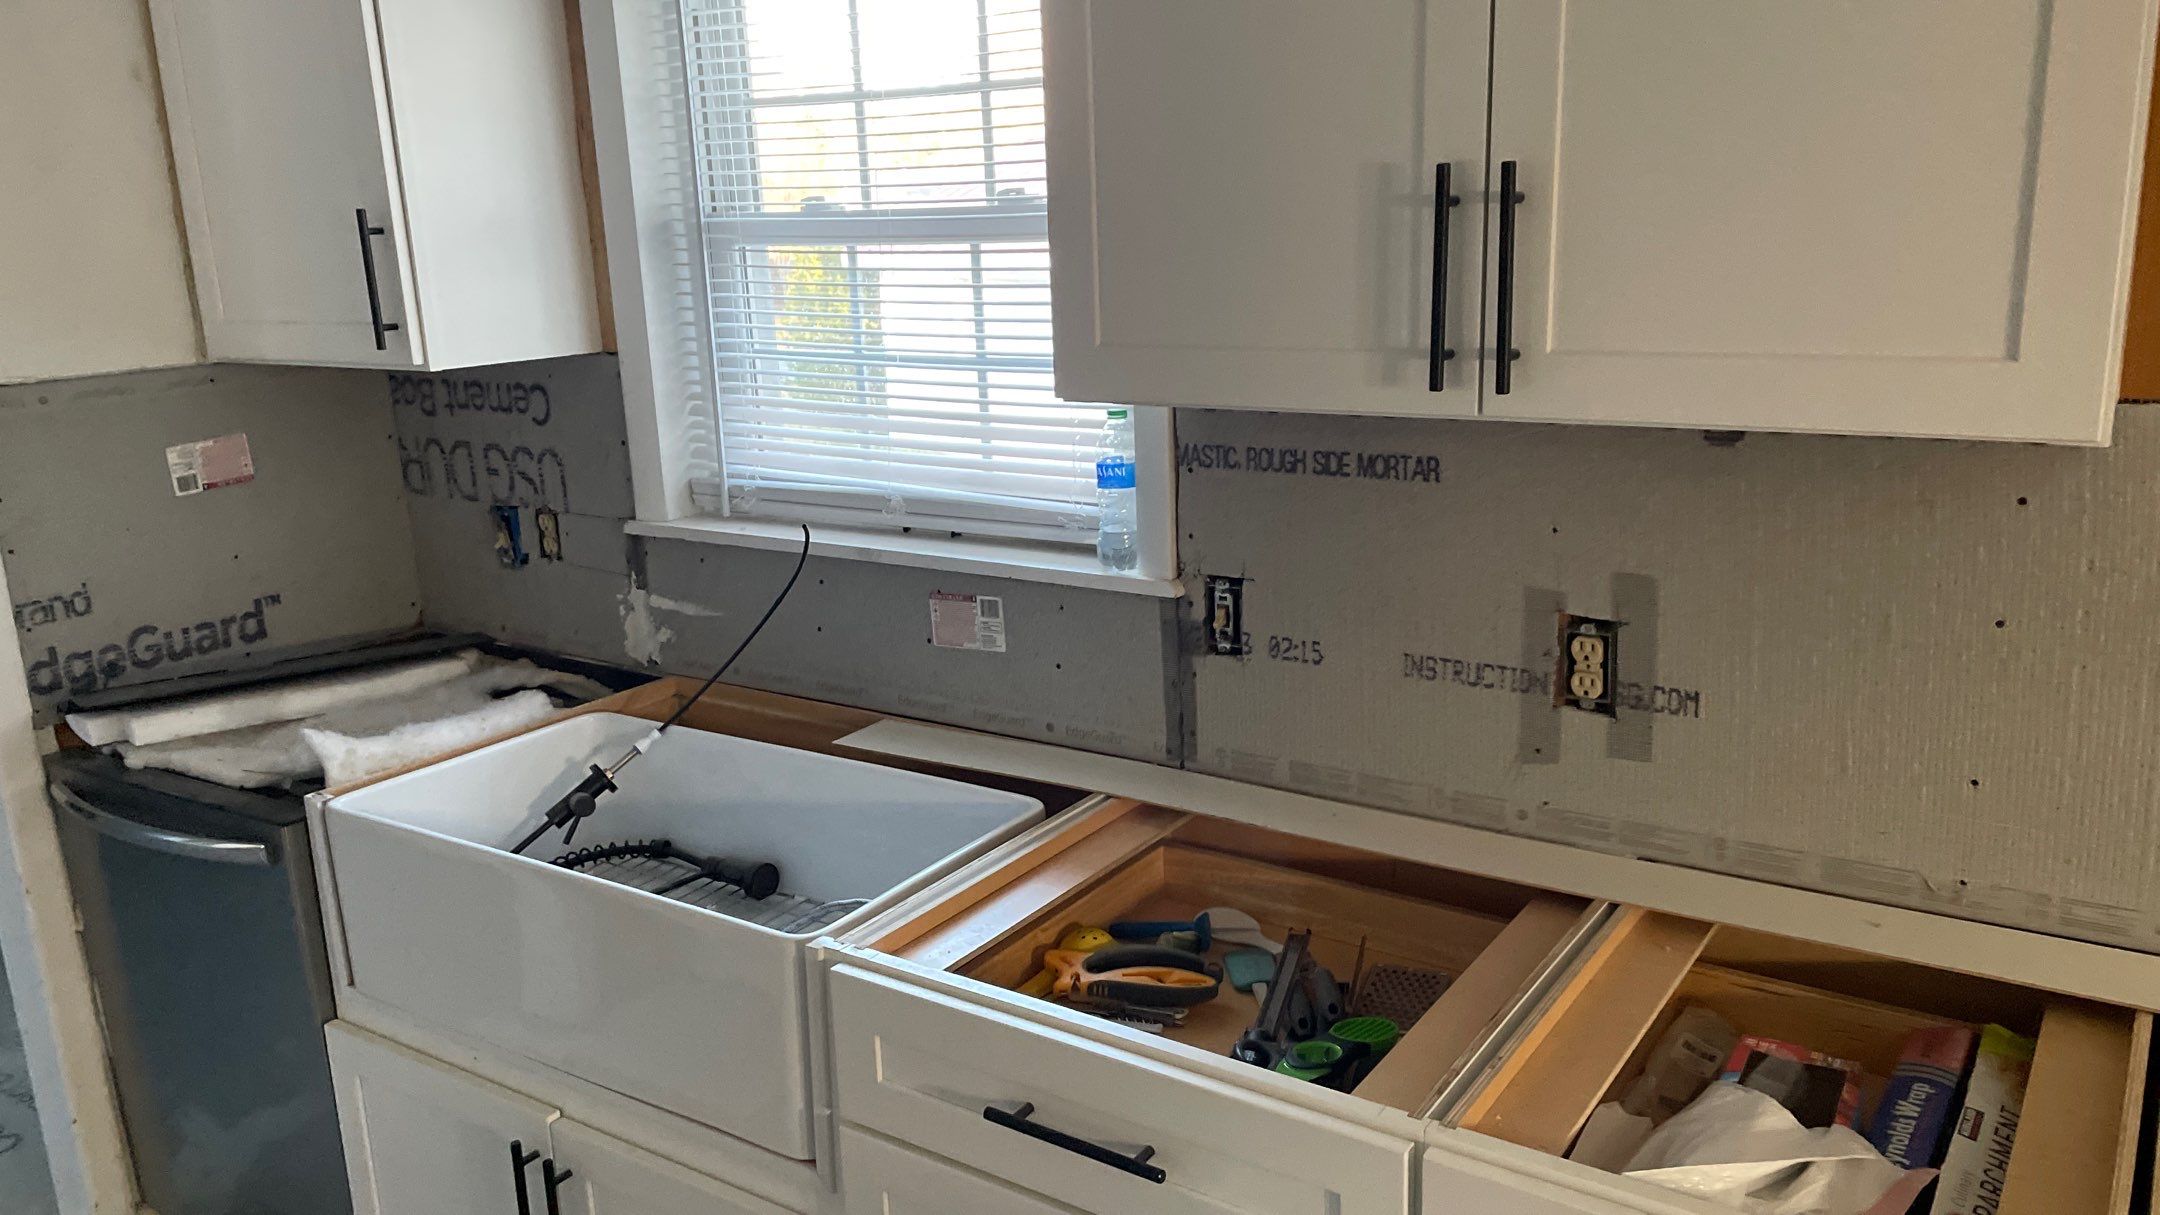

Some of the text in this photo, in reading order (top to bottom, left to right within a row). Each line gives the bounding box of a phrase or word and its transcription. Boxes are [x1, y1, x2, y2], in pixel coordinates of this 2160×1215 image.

[441, 379, 551, 426] Cement
[483, 444, 569, 513] USG
[1246, 446, 1306, 474] ROUGH
[1312, 450, 1351, 477] SIDE
[1357, 452, 1441, 483] MORTAR
[1268, 634, 1325, 666] 02:15
[1890, 1076, 1938, 1118] Wrap
[1972, 1104, 2021, 1215] PARCHMENT
